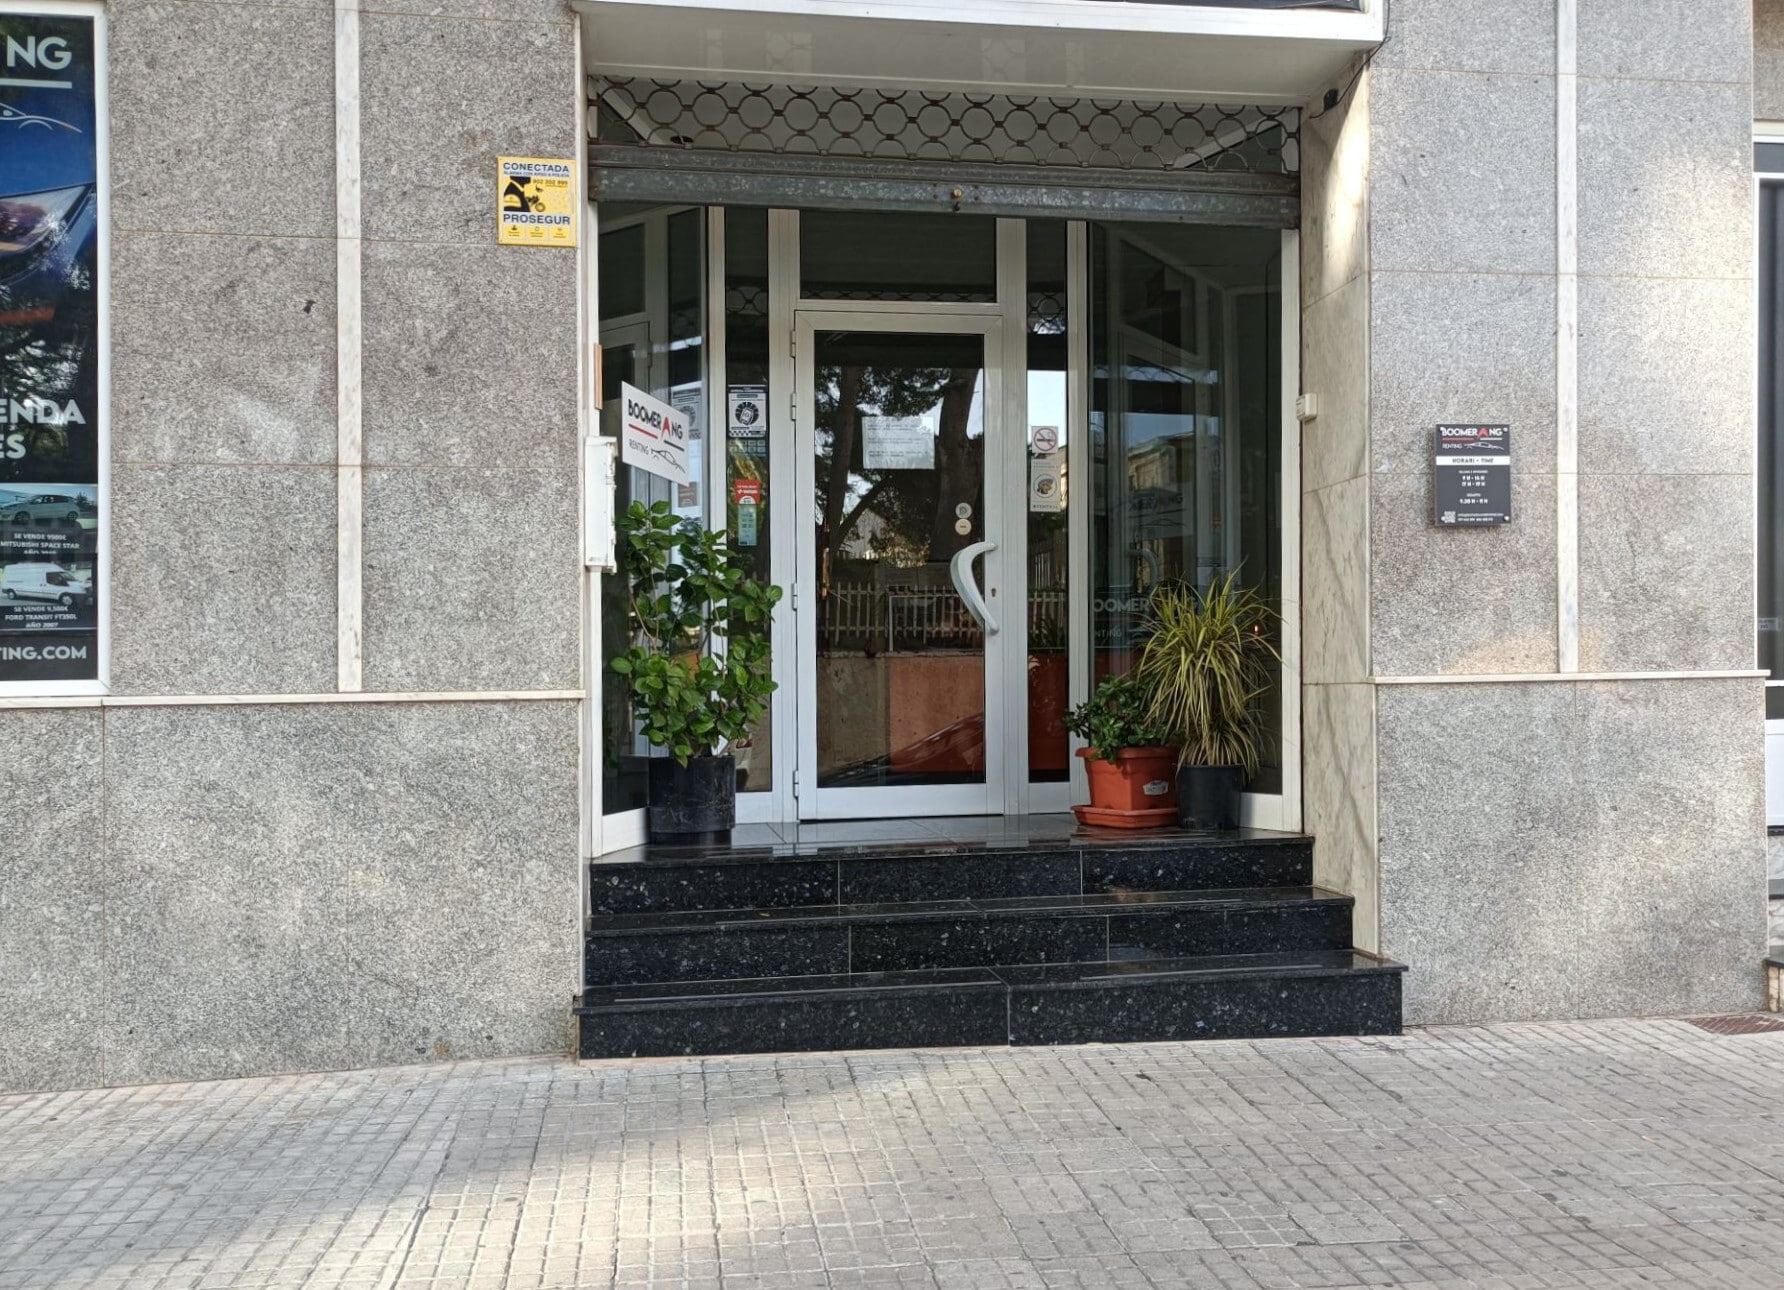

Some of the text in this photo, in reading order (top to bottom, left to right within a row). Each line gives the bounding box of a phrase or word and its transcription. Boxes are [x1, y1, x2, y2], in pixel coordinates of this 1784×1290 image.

[503, 162, 570, 172] CONECTADA
[503, 214, 570, 225] PROSEGUR
[628, 398, 683, 439] BOOMERANG
[1441, 427, 1503, 438] BOOMERANG
[629, 439, 649, 455] RENTING
[0, 645, 87, 660] ING.COM
